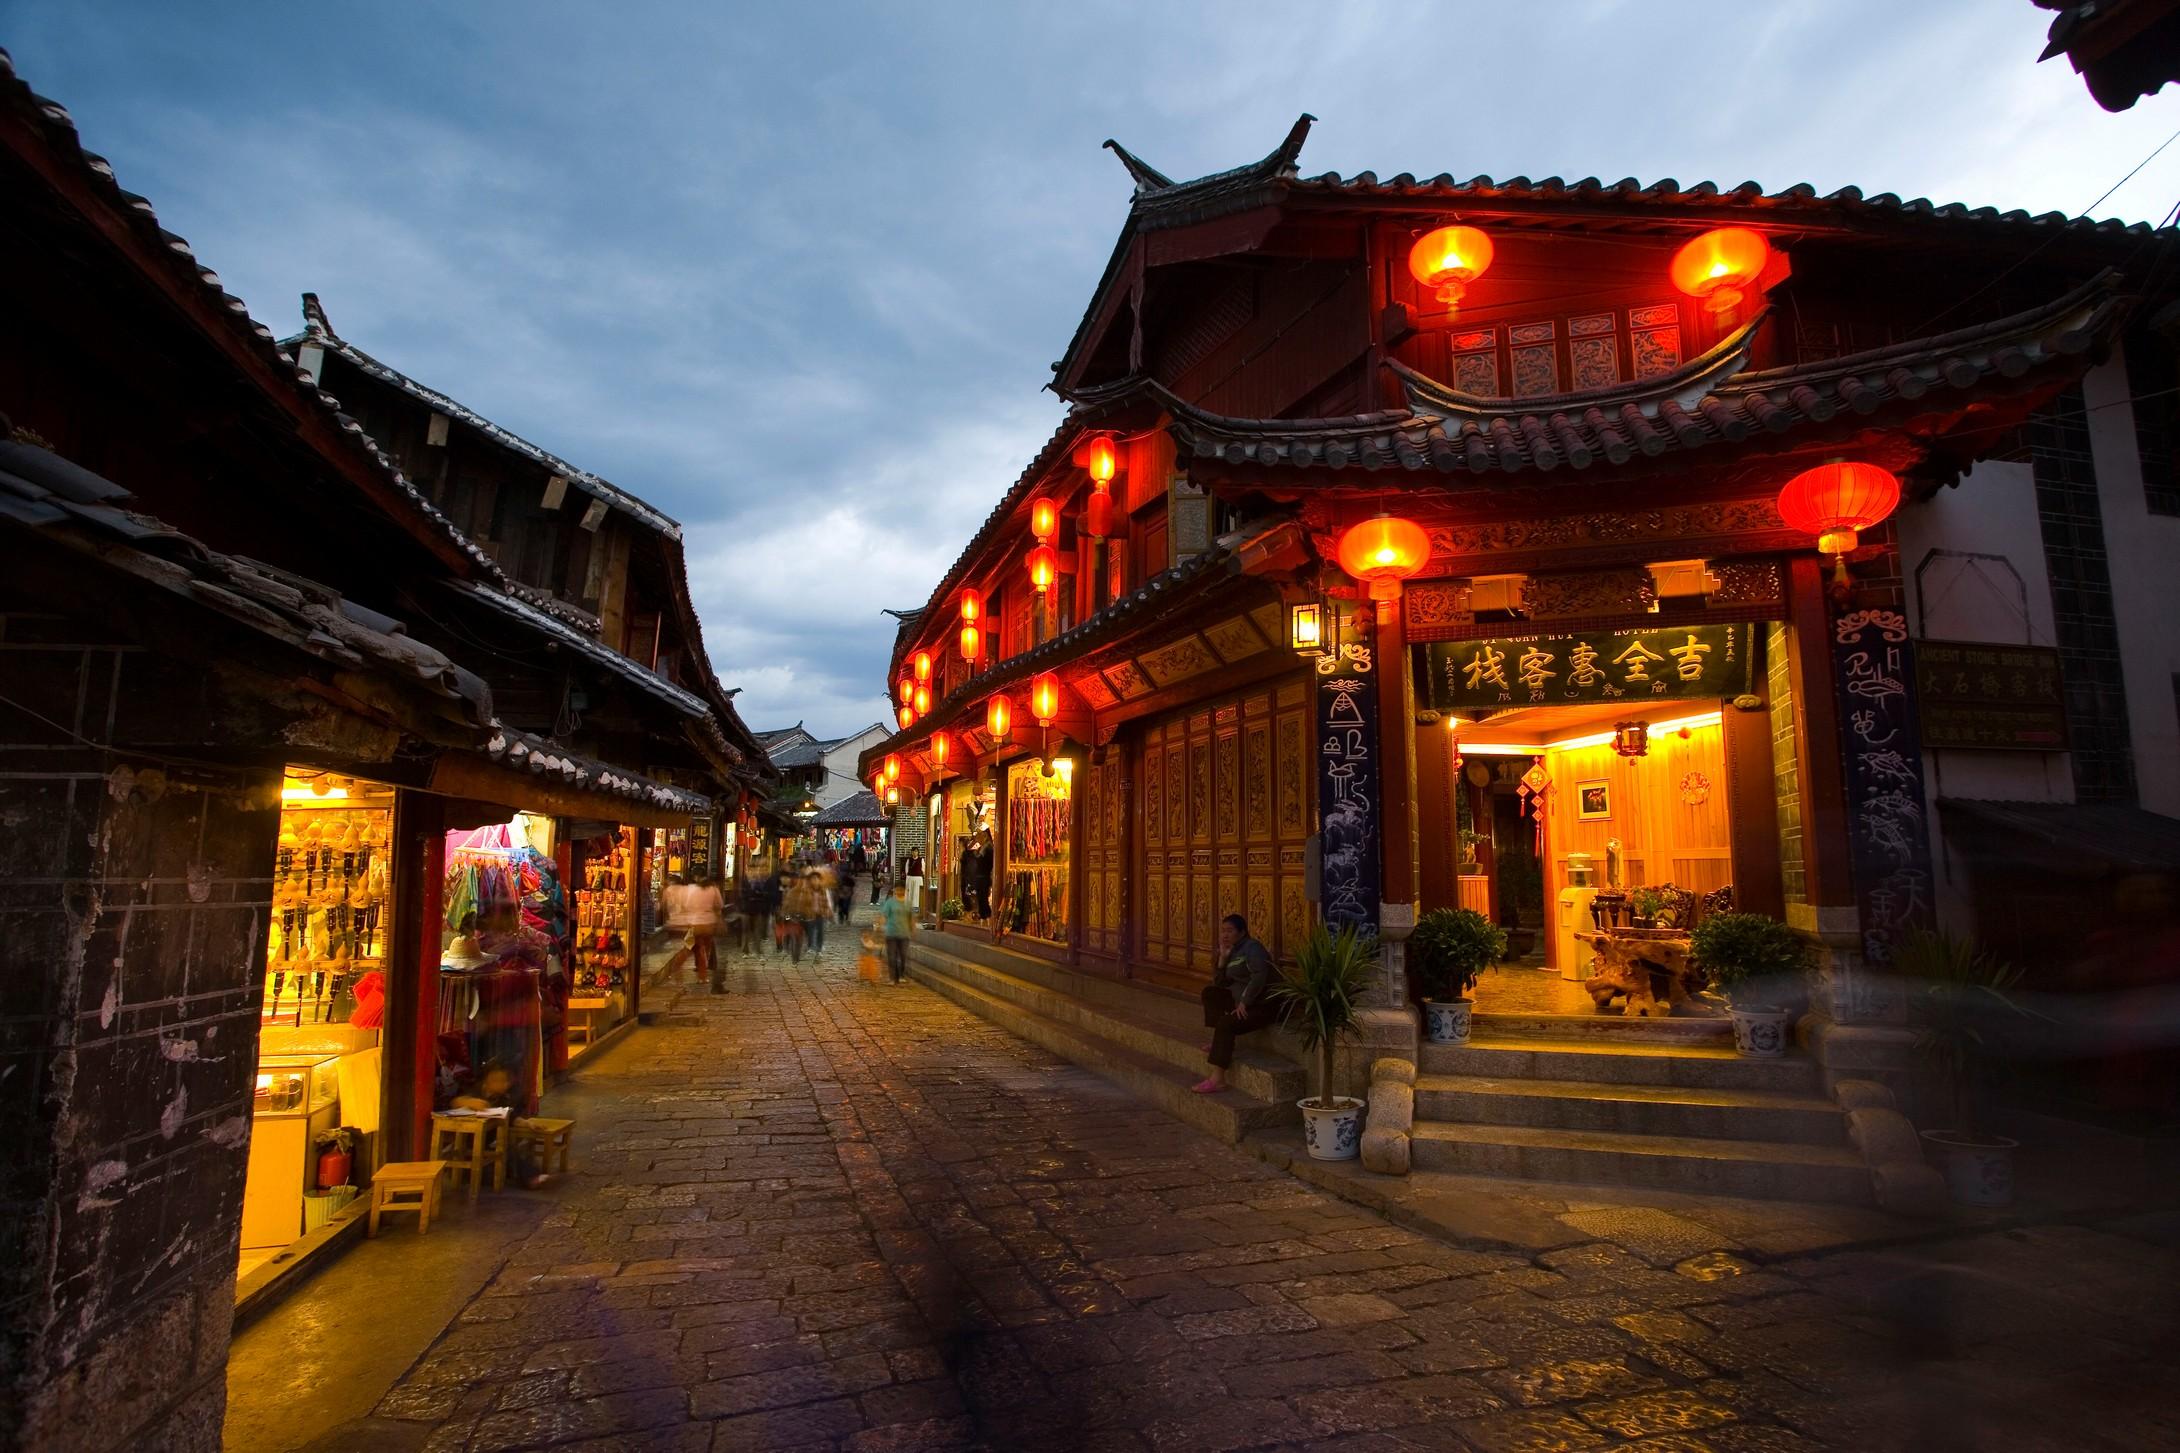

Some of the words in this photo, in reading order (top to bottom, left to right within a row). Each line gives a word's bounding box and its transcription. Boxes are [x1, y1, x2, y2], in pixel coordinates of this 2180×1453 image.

[1966, 651, 2000, 665] STONE
[691, 825, 708, 869] 龍源客
